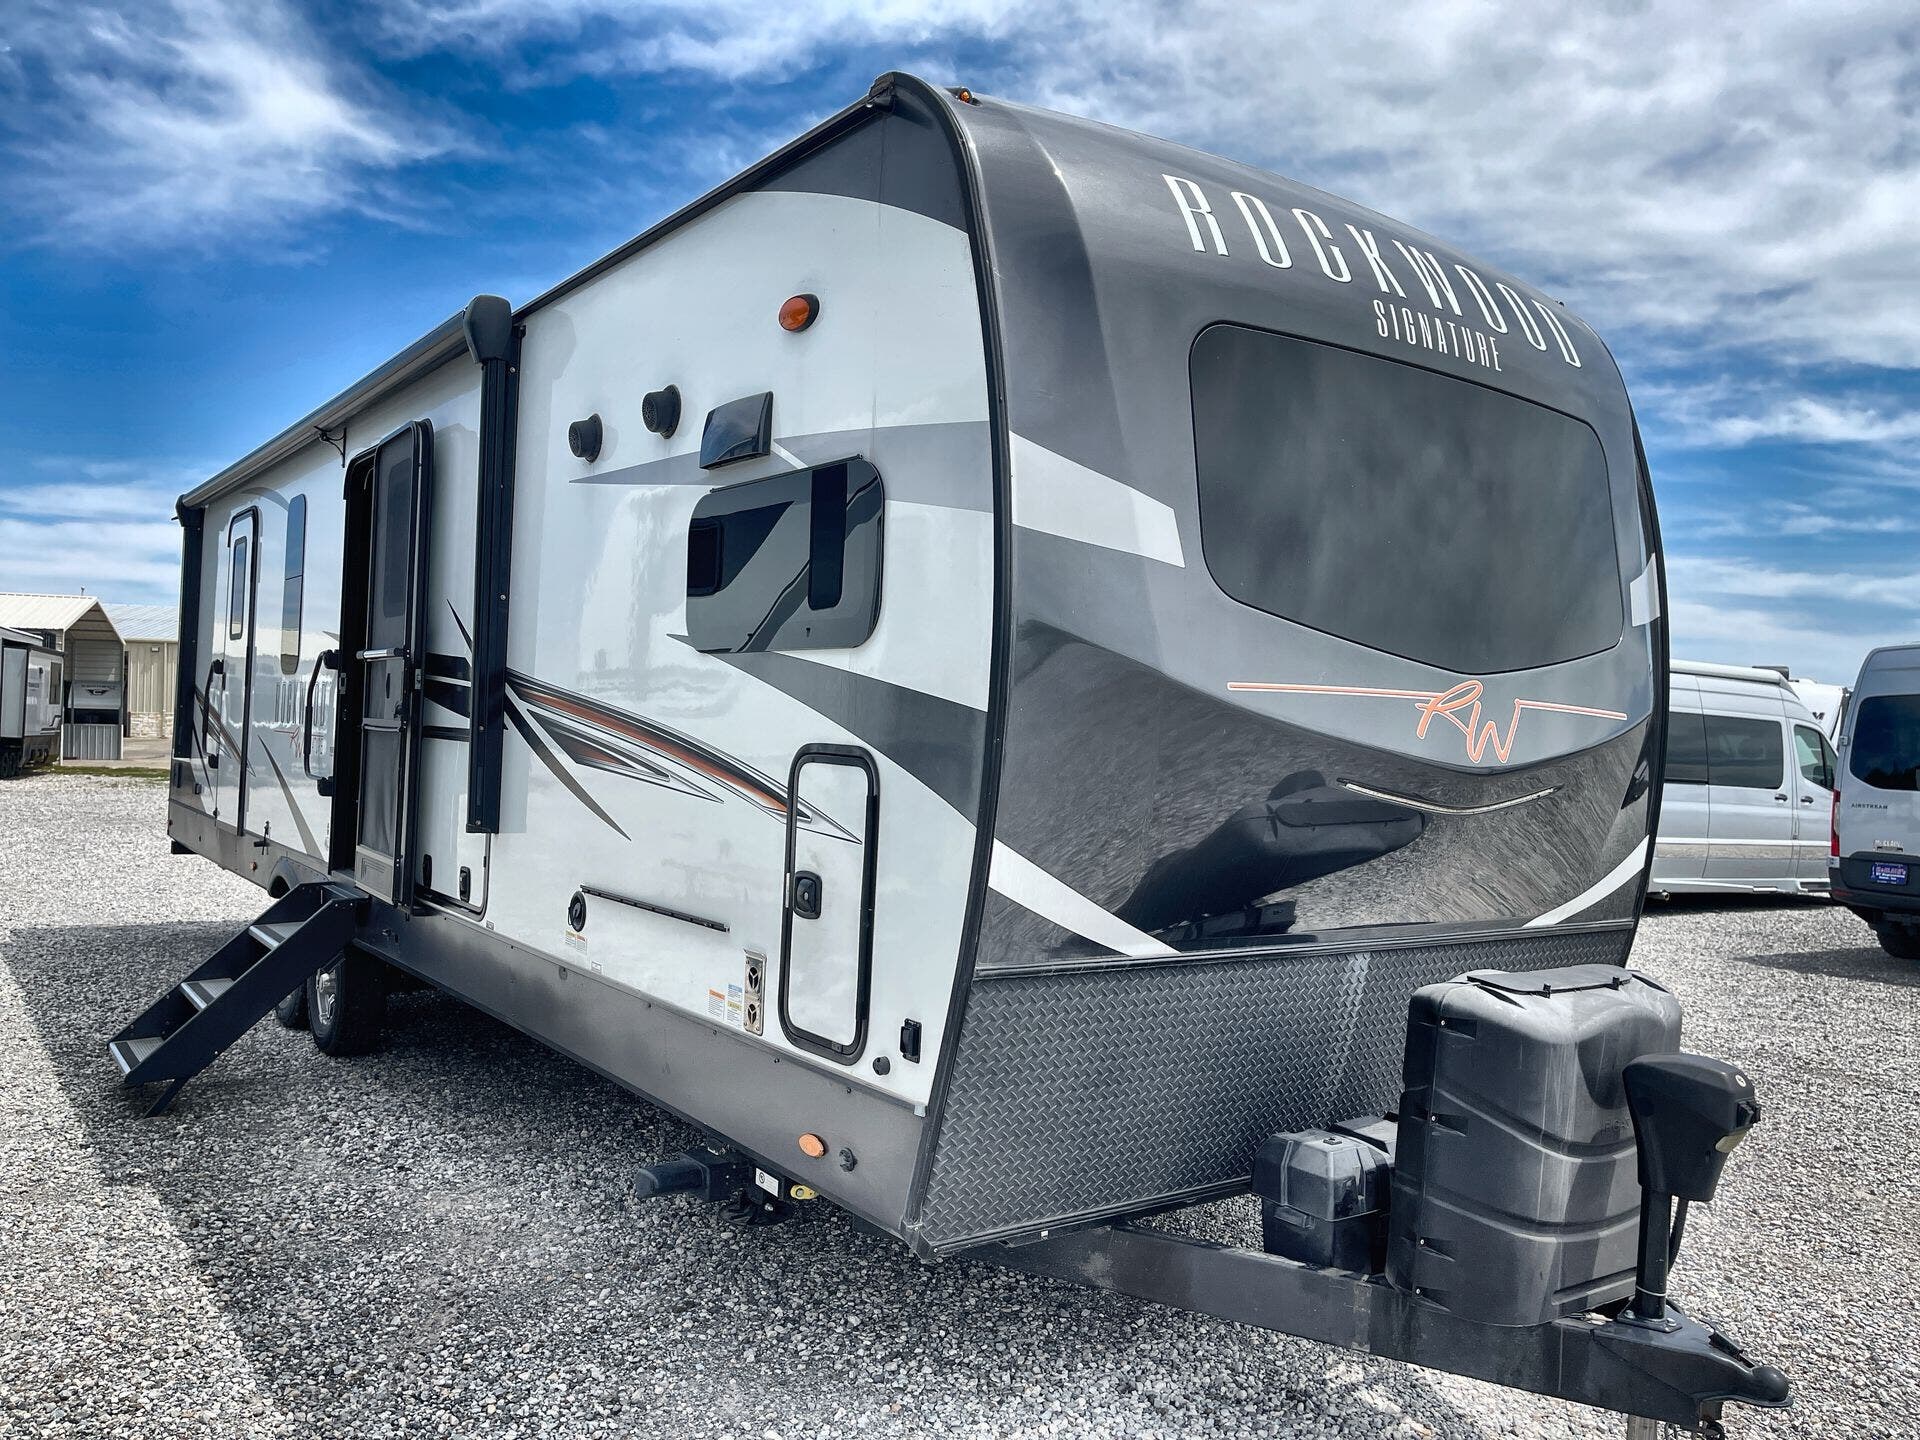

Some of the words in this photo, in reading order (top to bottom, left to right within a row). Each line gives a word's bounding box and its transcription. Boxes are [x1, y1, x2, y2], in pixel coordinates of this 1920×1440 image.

[1162, 173, 1583, 369] ROCKWOOD
[1372, 299, 1503, 372] SIGNATURE
[1414, 679, 1521, 764] RW
[1850, 802, 1889, 810] AIRSTREAM
